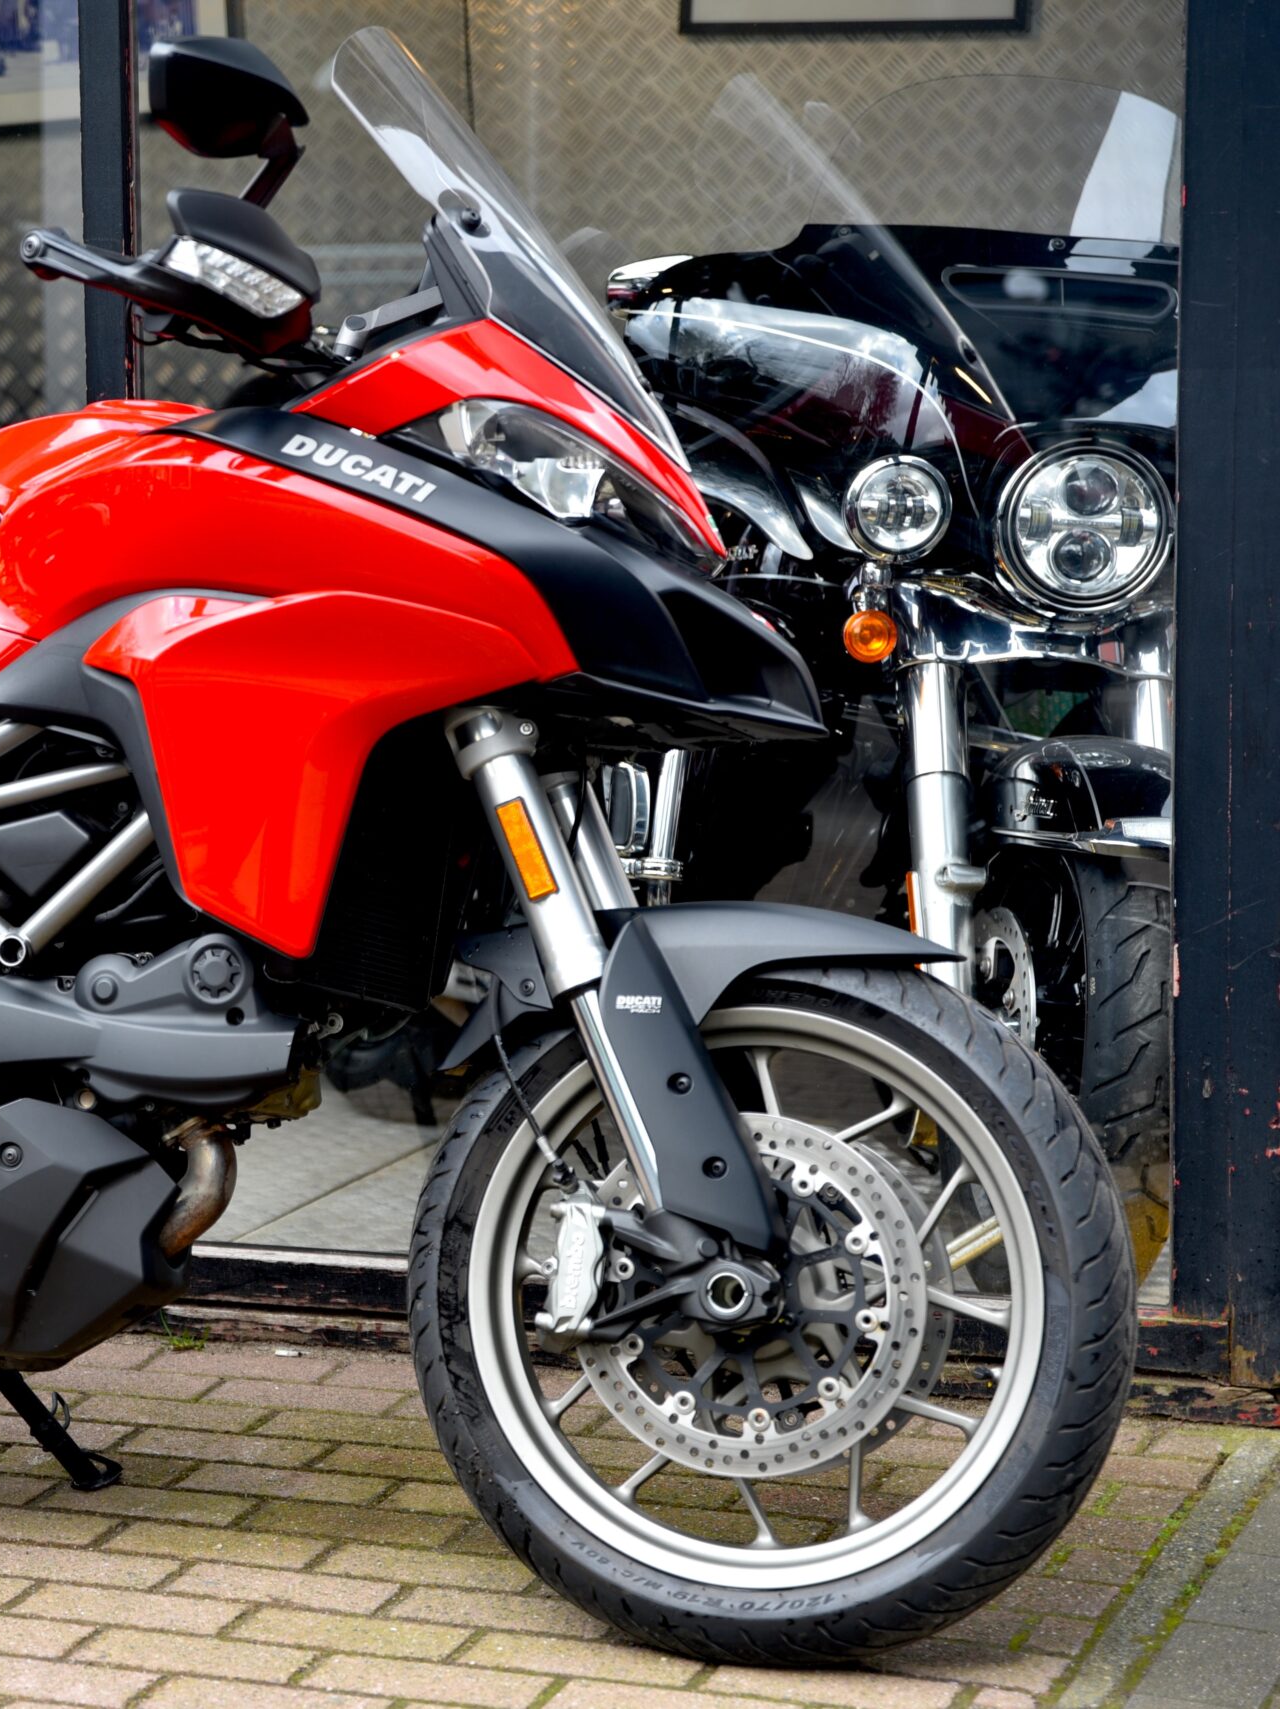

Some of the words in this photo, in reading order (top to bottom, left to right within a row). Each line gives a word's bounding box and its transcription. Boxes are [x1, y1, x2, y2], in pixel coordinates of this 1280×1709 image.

[280, 434, 437, 503] DUCATI
[616, 995, 662, 1005] DUCATI
[560, 1230, 586, 1309] brembo
[739, 1593, 836, 1612] 120/70
